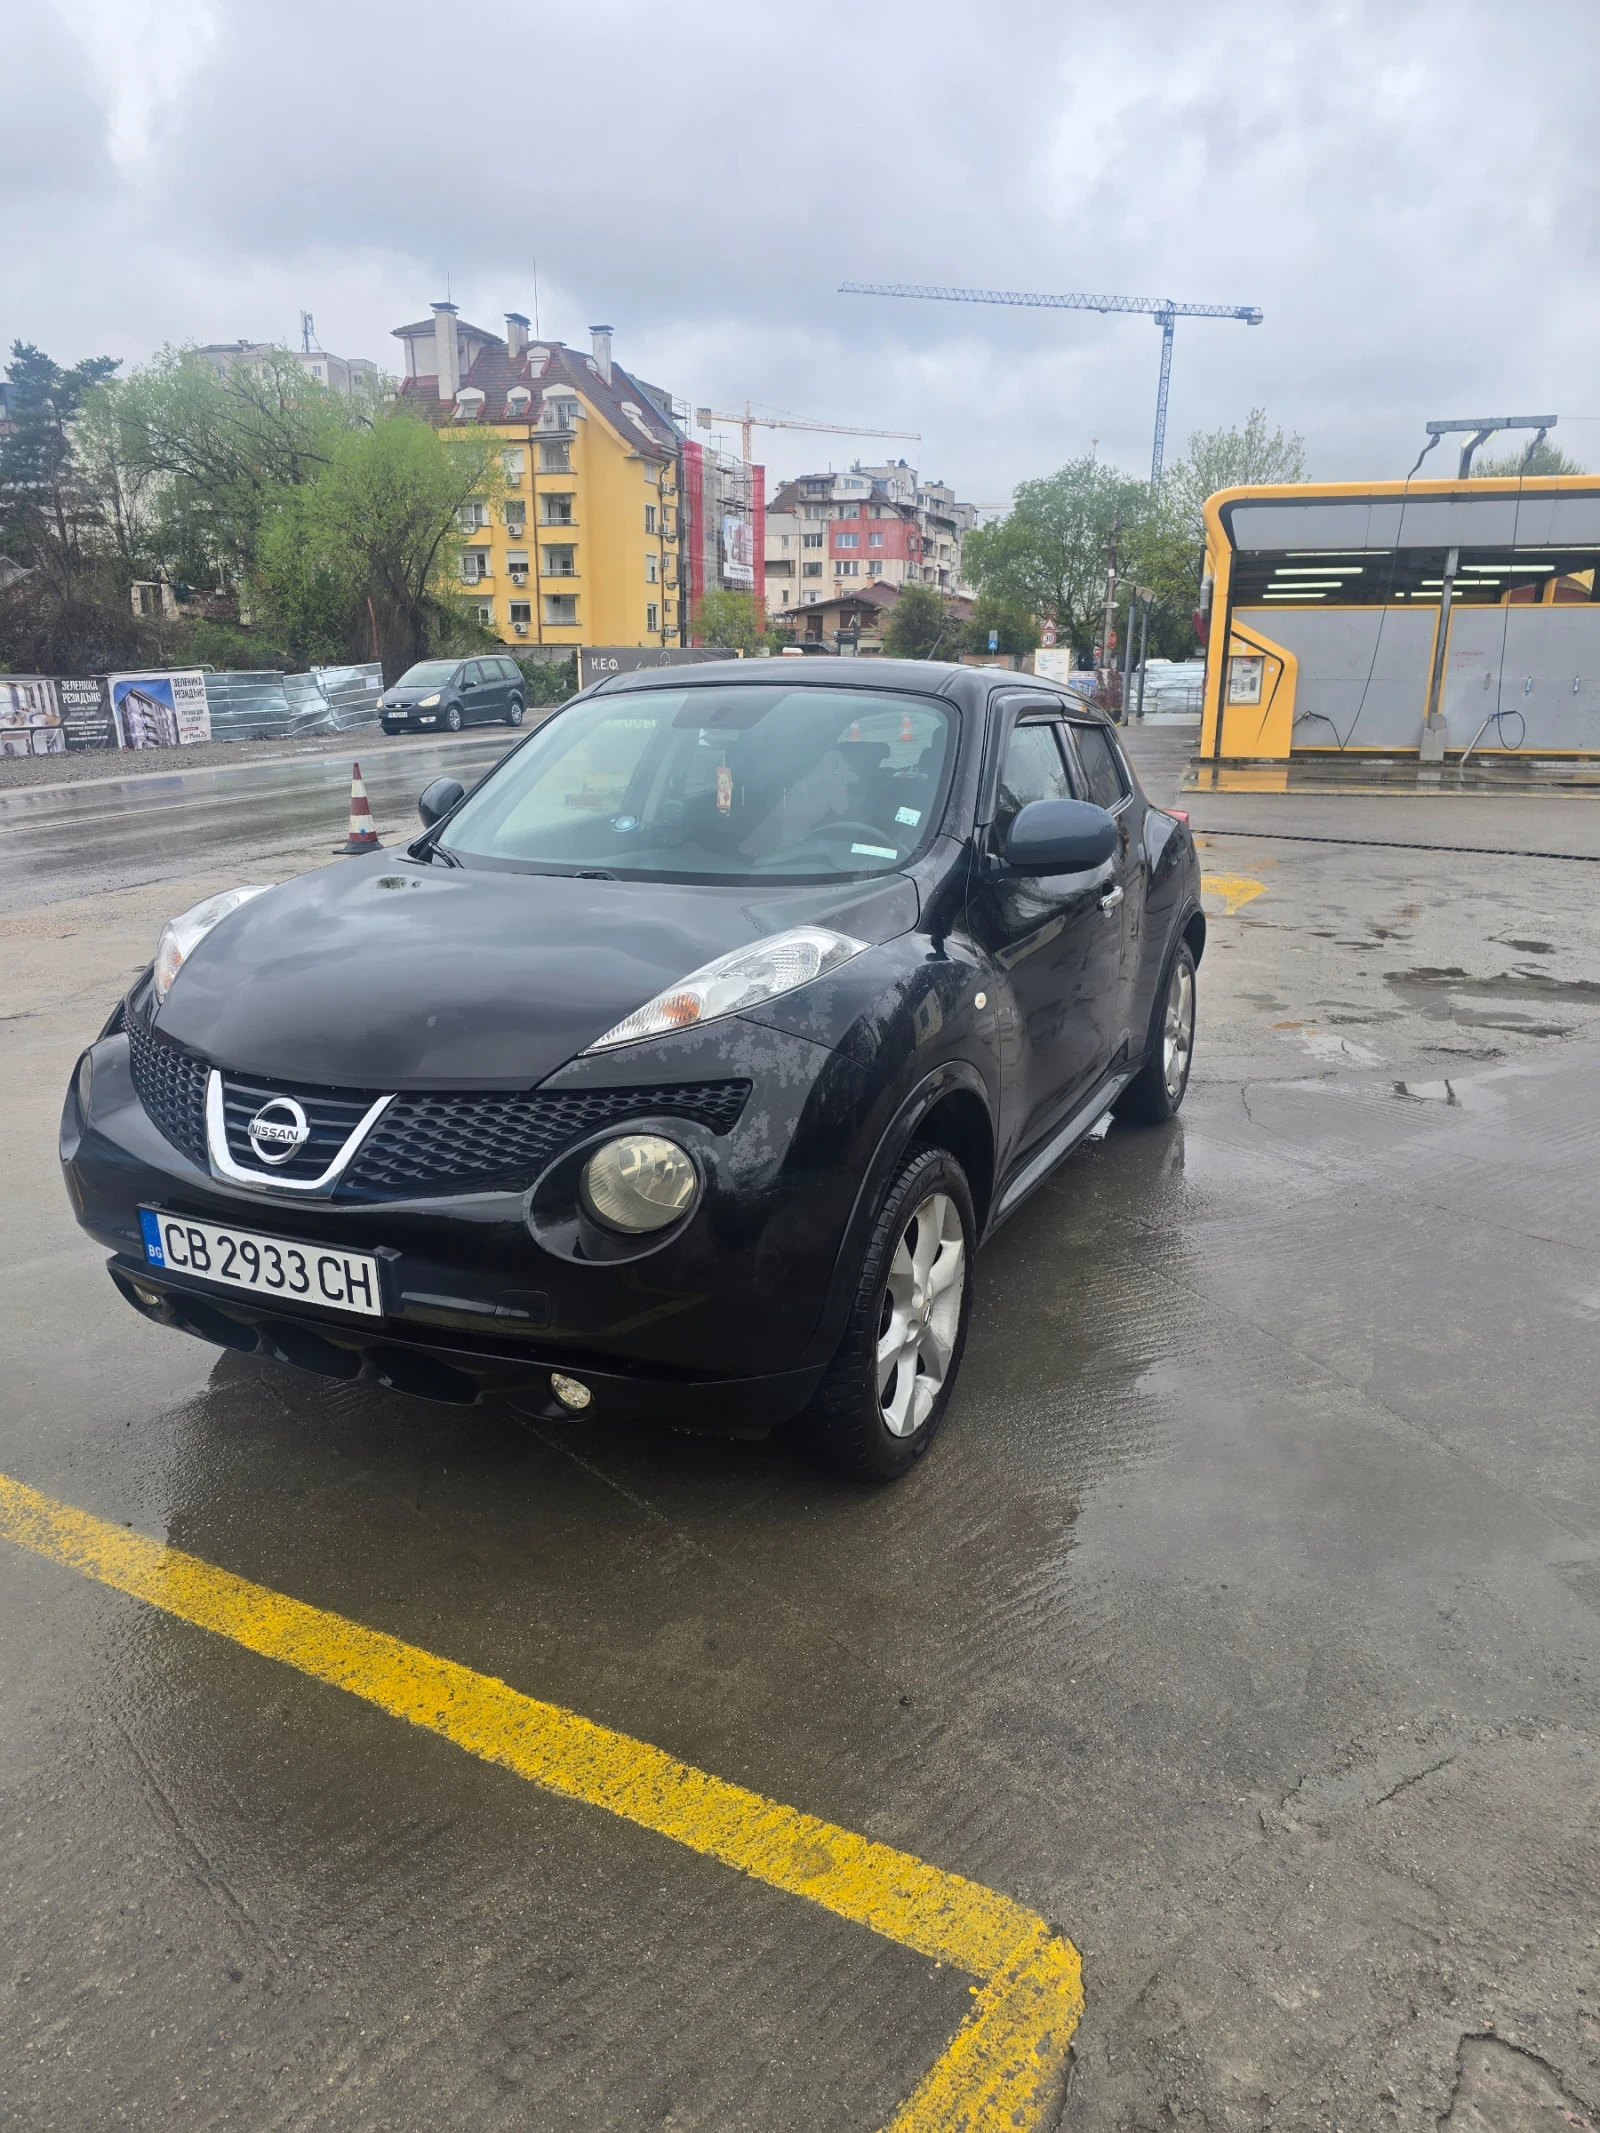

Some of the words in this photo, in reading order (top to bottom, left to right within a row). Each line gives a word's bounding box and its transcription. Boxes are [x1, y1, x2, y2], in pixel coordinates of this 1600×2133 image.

[1044, 634, 1053, 643] 30
[591, 657, 619, 671] К.Е.Ф.
[61, 680, 98, 691] ЗЕЛЕНИКА
[173, 676, 203, 688] ЗЕЛЕНИКА
[62, 692, 101, 704] РЕЗИДЪНС
[174, 688, 205, 700] РЕЗИДЪНС
[249, 1122, 299, 1141] NISSAN
[147, 1243, 163, 1260] BG
[164, 1223, 212, 1273] CB
[216, 1235, 310, 1294] 2933
[317, 1256, 373, 1309] CH
